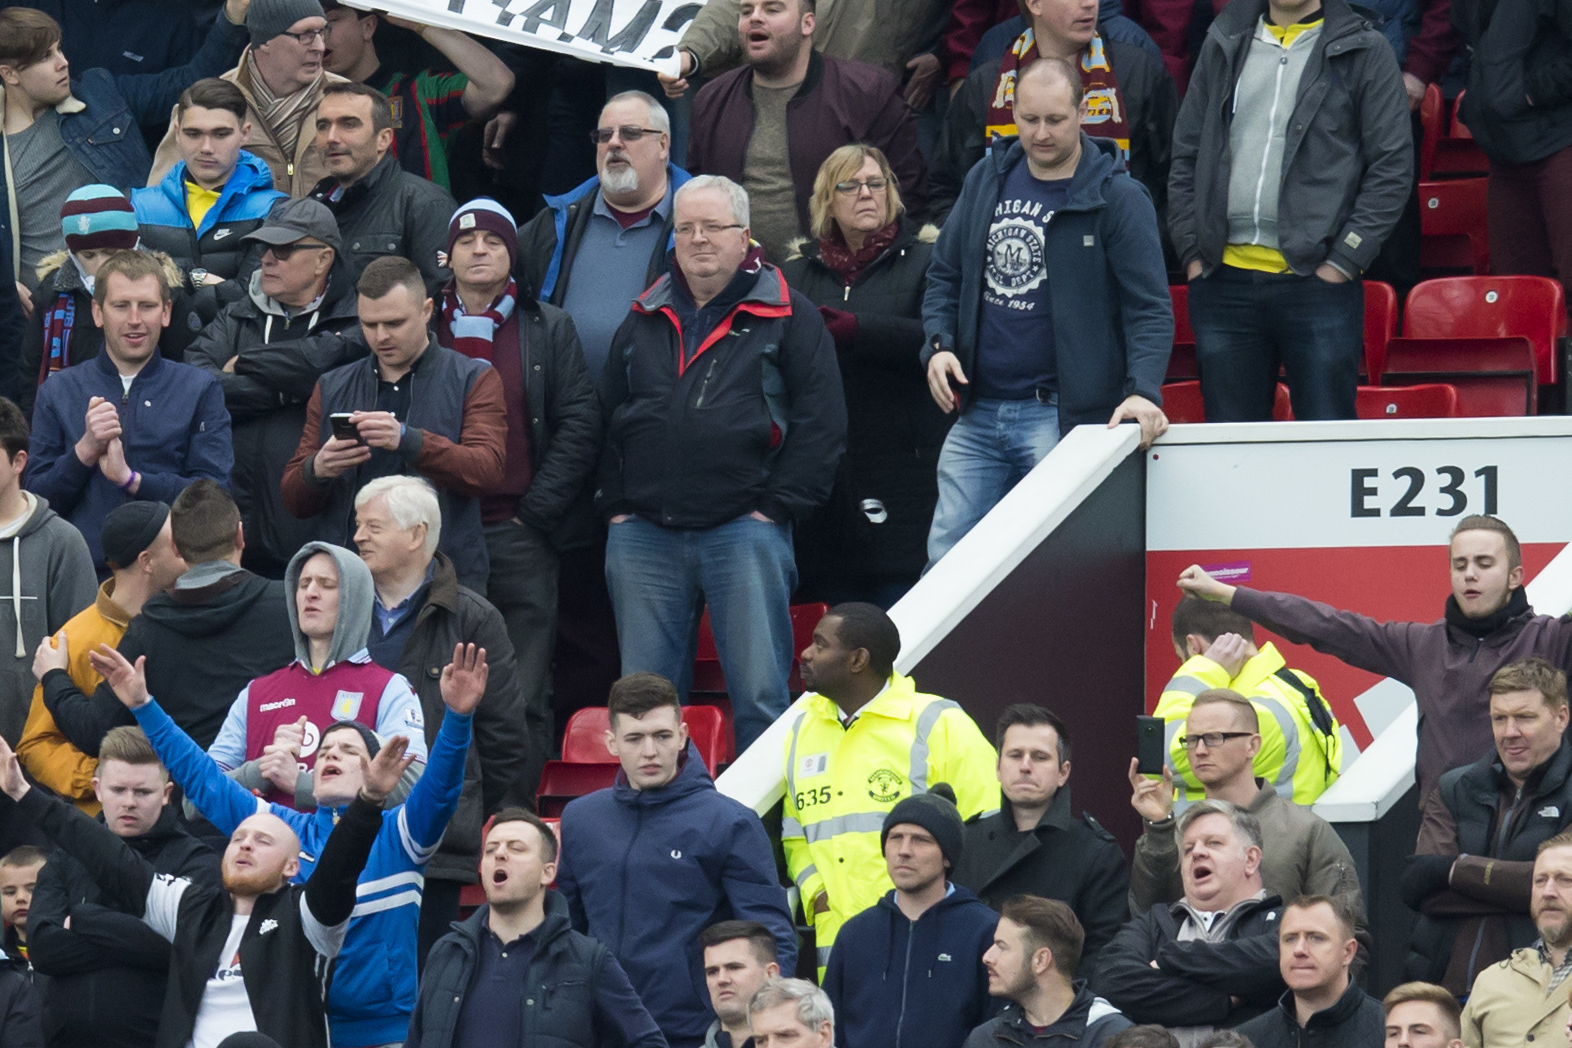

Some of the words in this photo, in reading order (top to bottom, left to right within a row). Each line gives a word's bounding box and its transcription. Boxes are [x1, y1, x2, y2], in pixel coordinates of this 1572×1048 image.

[1007, 300, 1036, 310] 1954
[259, 698, 296, 713] macron
[795, 785, 832, 811] 635
